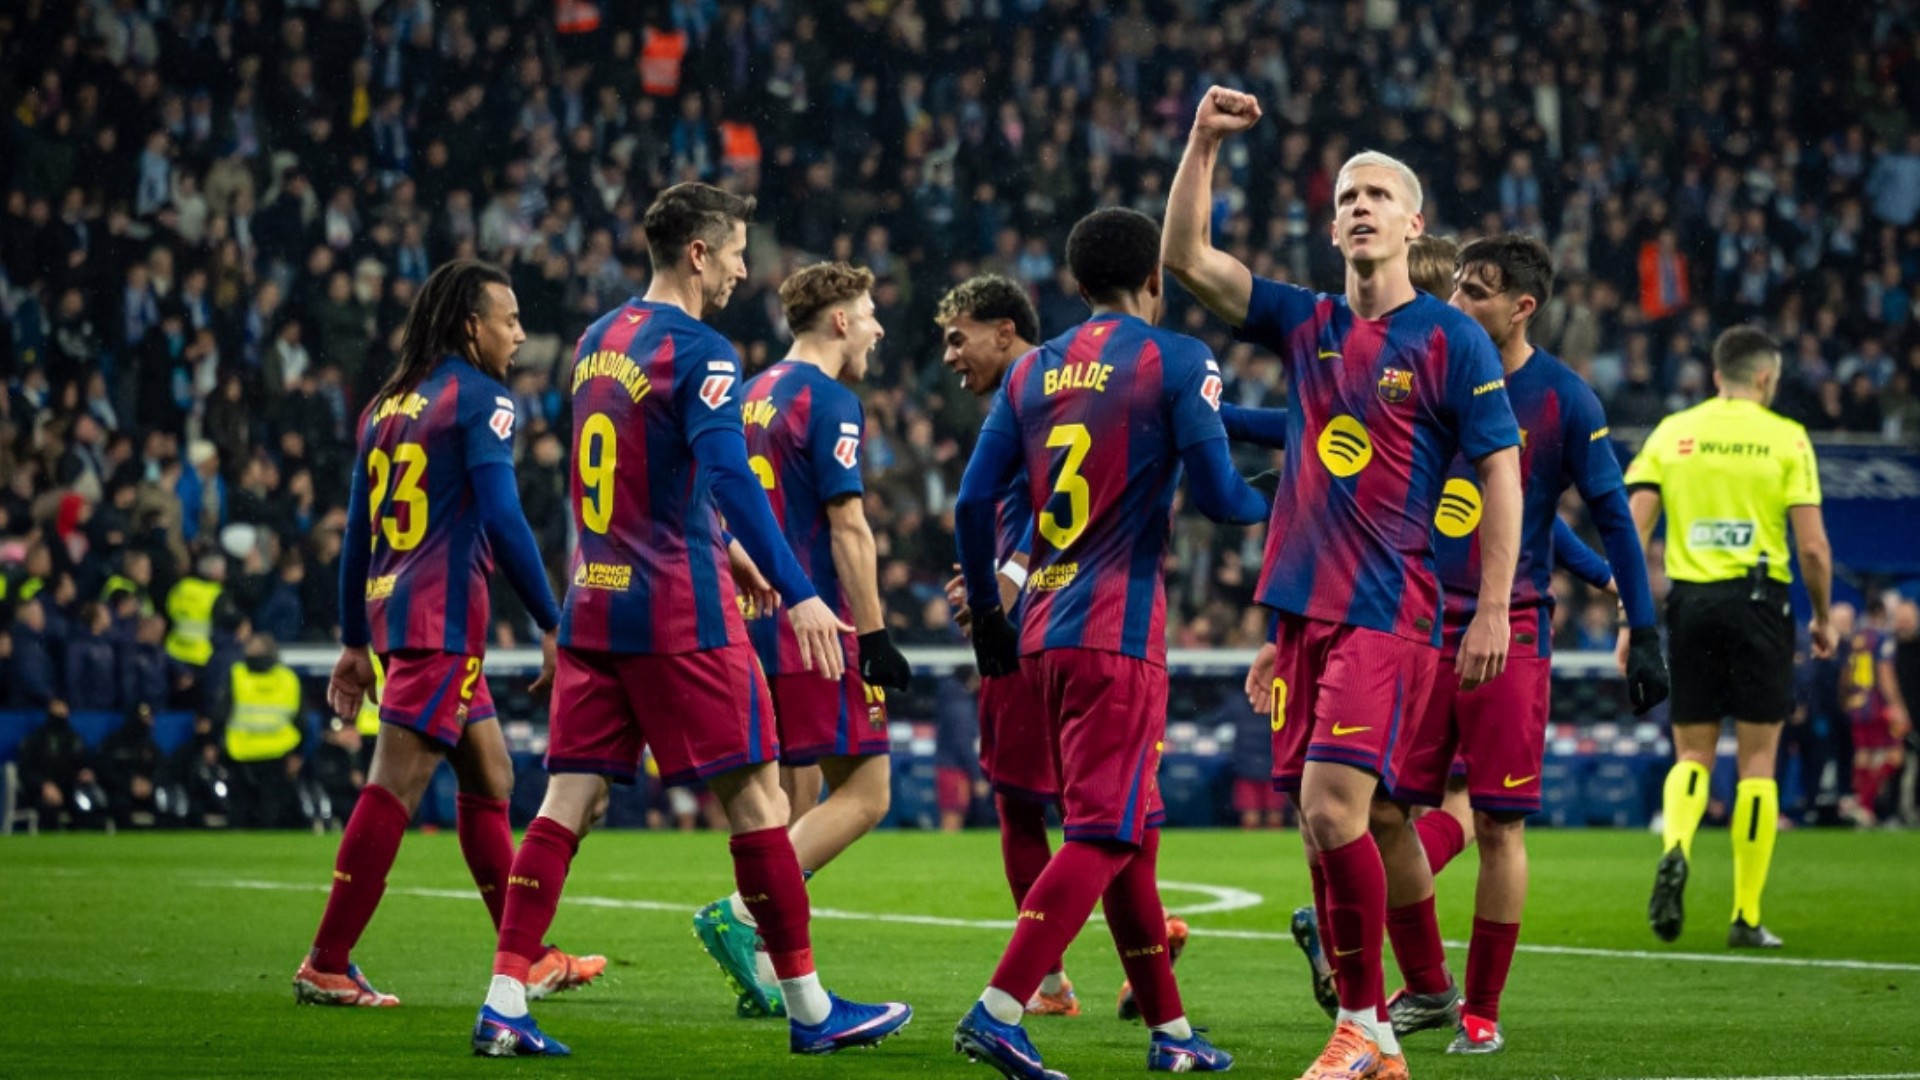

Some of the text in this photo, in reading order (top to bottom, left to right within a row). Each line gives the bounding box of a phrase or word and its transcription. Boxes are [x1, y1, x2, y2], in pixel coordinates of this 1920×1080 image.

[572, 350, 652, 404] EWANDOWSKI
[1044, 361, 1114, 395] BALDE
[368, 443, 428, 553] 23
[579, 412, 616, 534] 9
[1039, 424, 1092, 550] 3
[1690, 523, 1752, 544] BKT
[461, 657, 480, 699] 2
